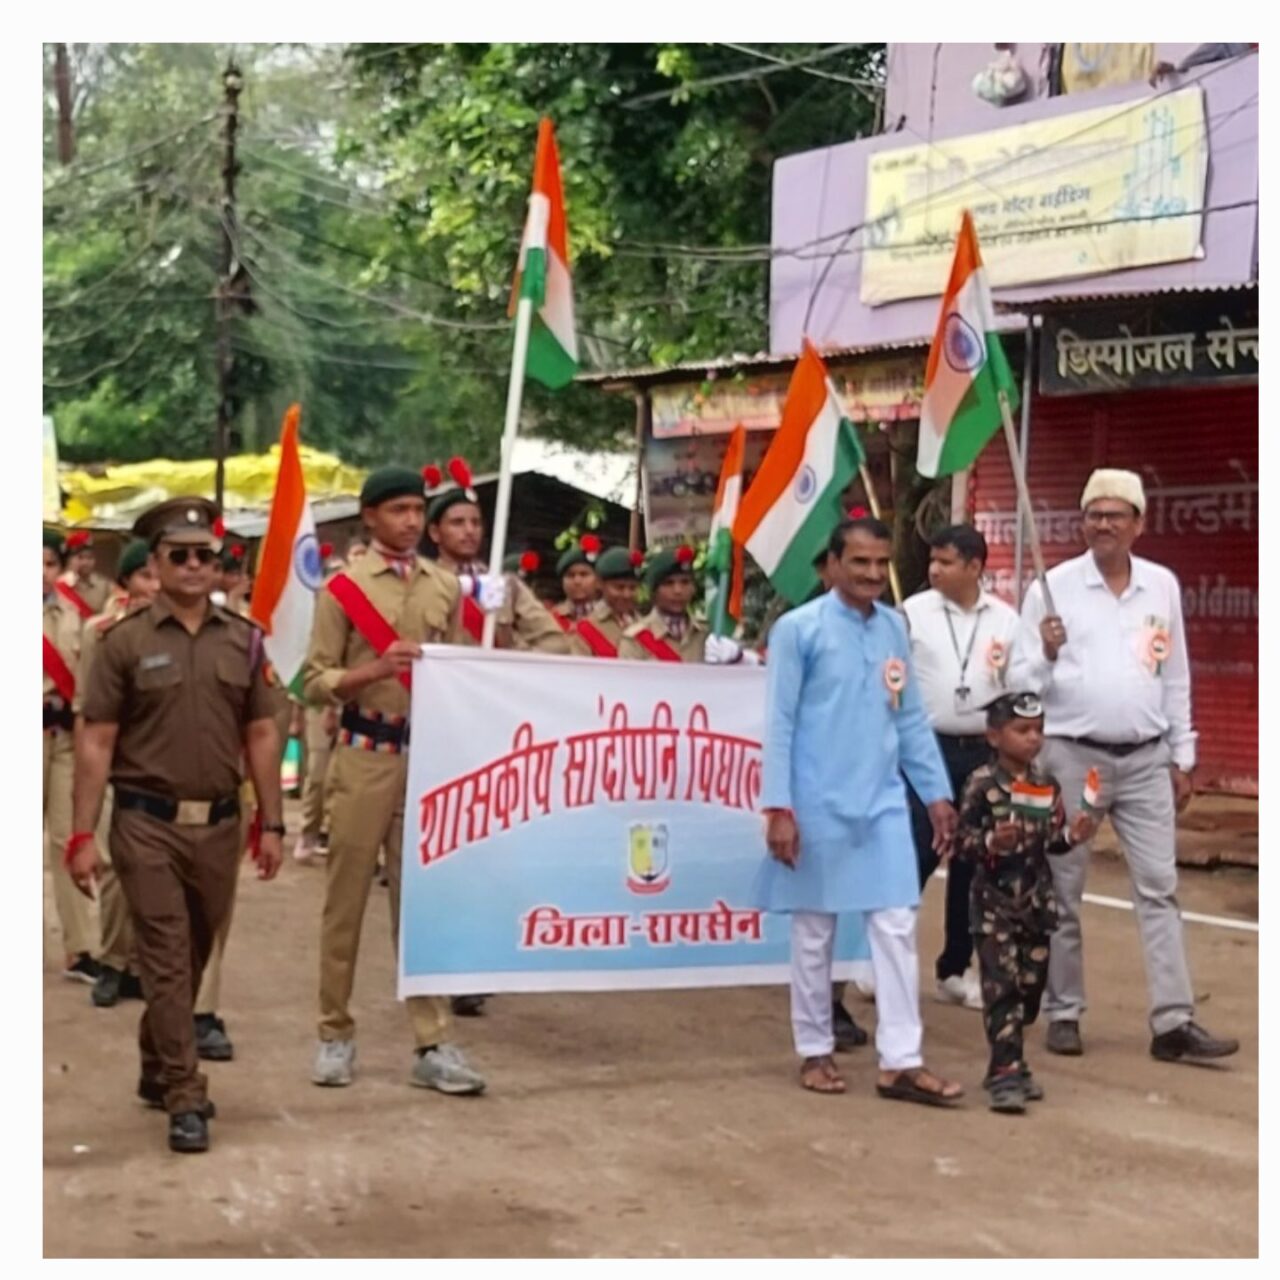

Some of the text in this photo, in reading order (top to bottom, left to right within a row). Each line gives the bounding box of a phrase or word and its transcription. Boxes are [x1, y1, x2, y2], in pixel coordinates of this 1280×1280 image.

[1057, 325, 1195, 378] डिस्पोजल
[1183, 574, 1259, 616] oldm
[419, 694, 762, 866] शासकीय सांदीपनि विद्याल
[520, 900, 764, 947] जिला-रायसेन
